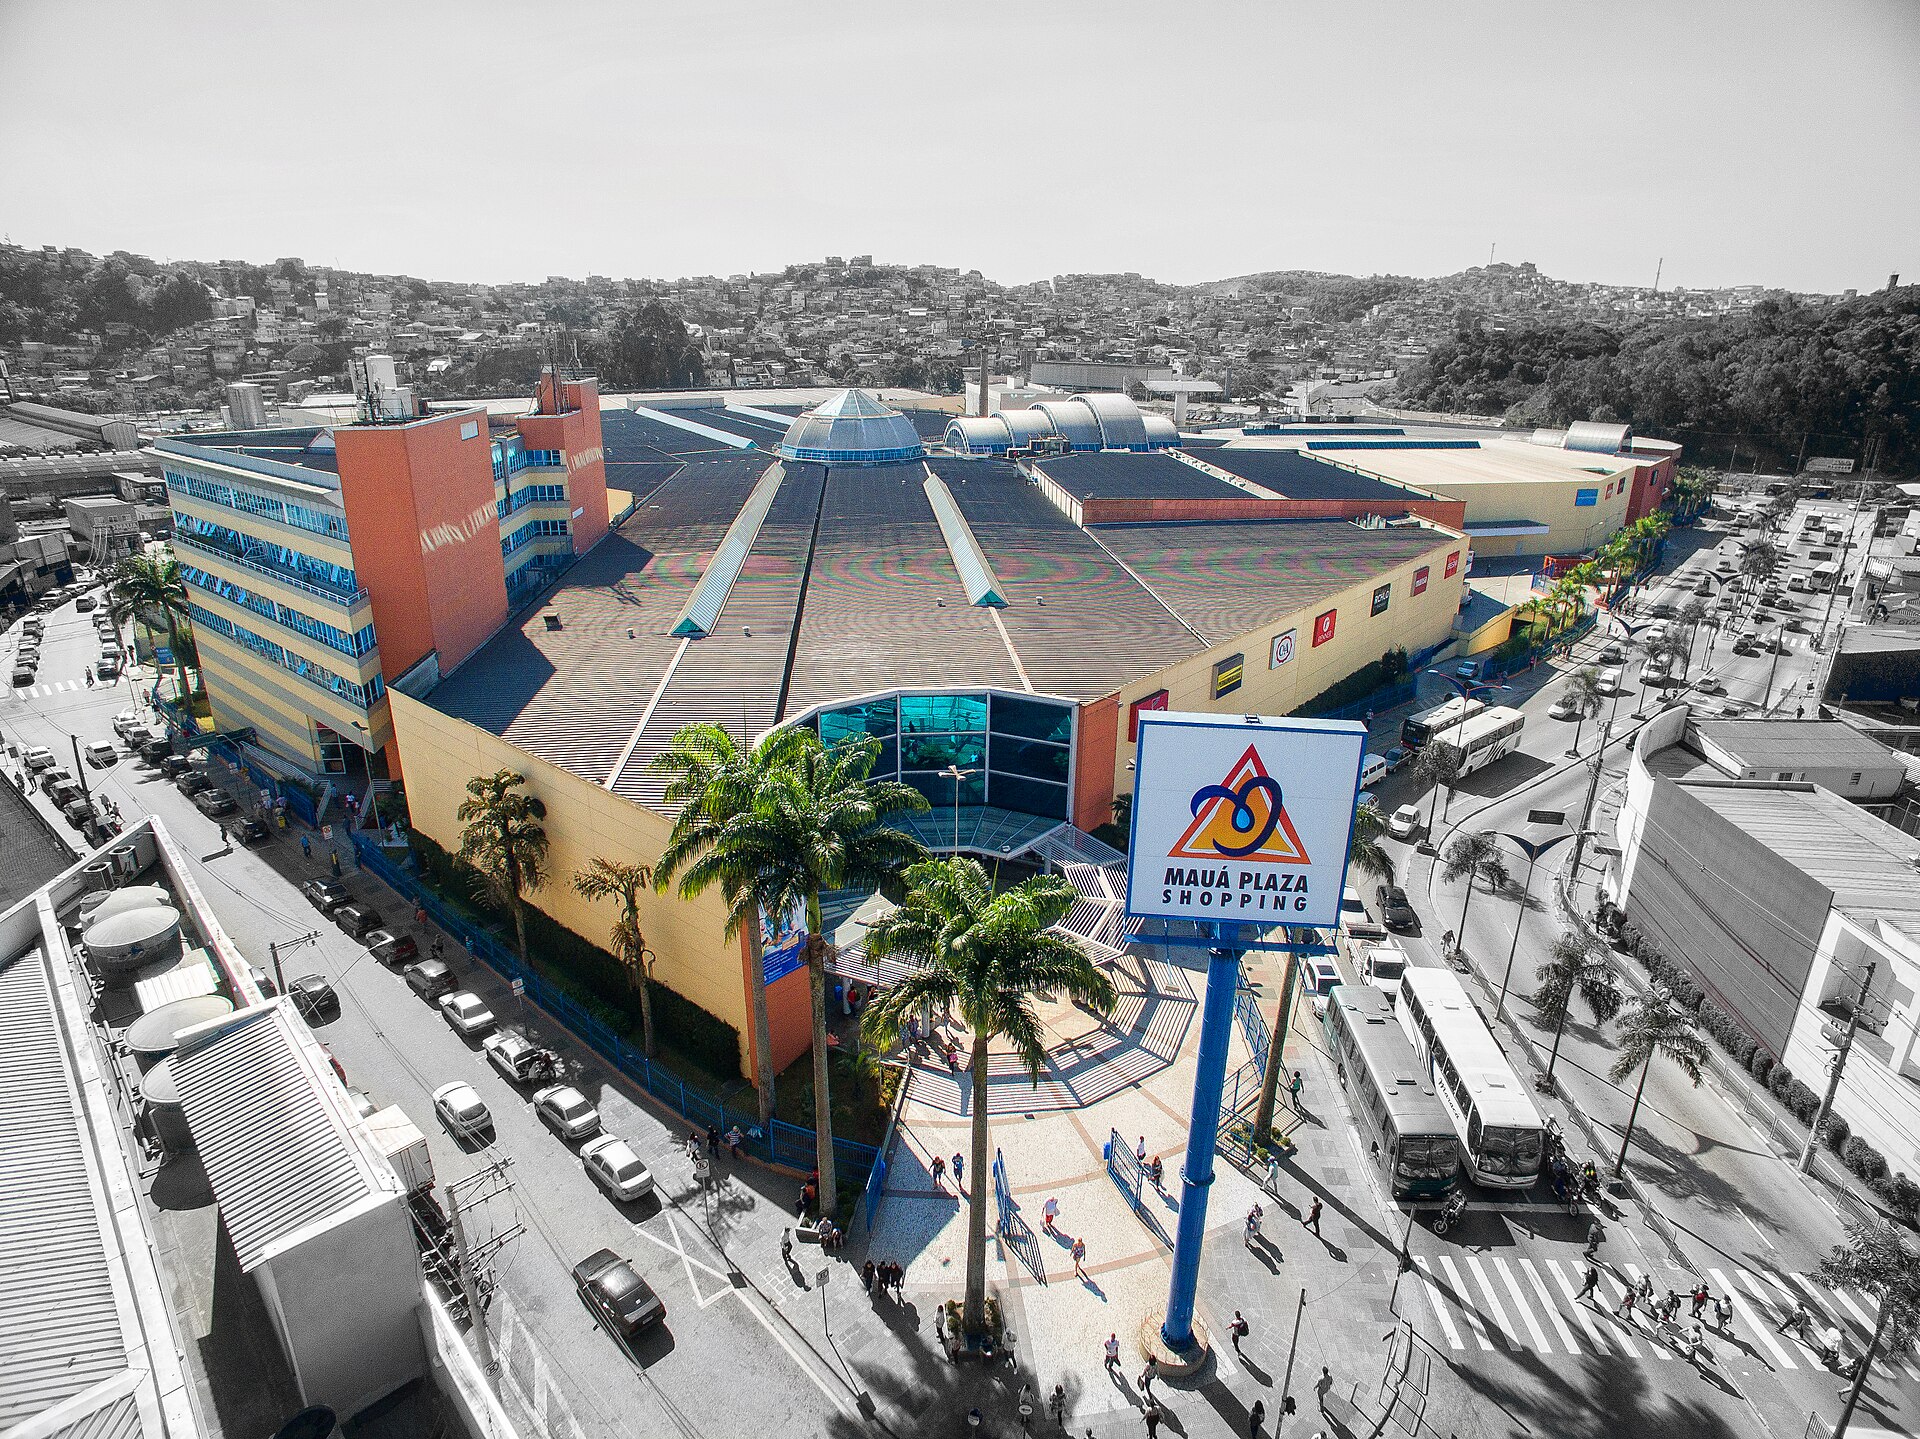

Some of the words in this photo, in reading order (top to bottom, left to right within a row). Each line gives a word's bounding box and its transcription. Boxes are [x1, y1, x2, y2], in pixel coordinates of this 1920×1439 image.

[1163, 866, 1230, 889] MAUÁ
[1238, 871, 1309, 893] PLAZA
[1162, 889, 1307, 911] SHOPPING
